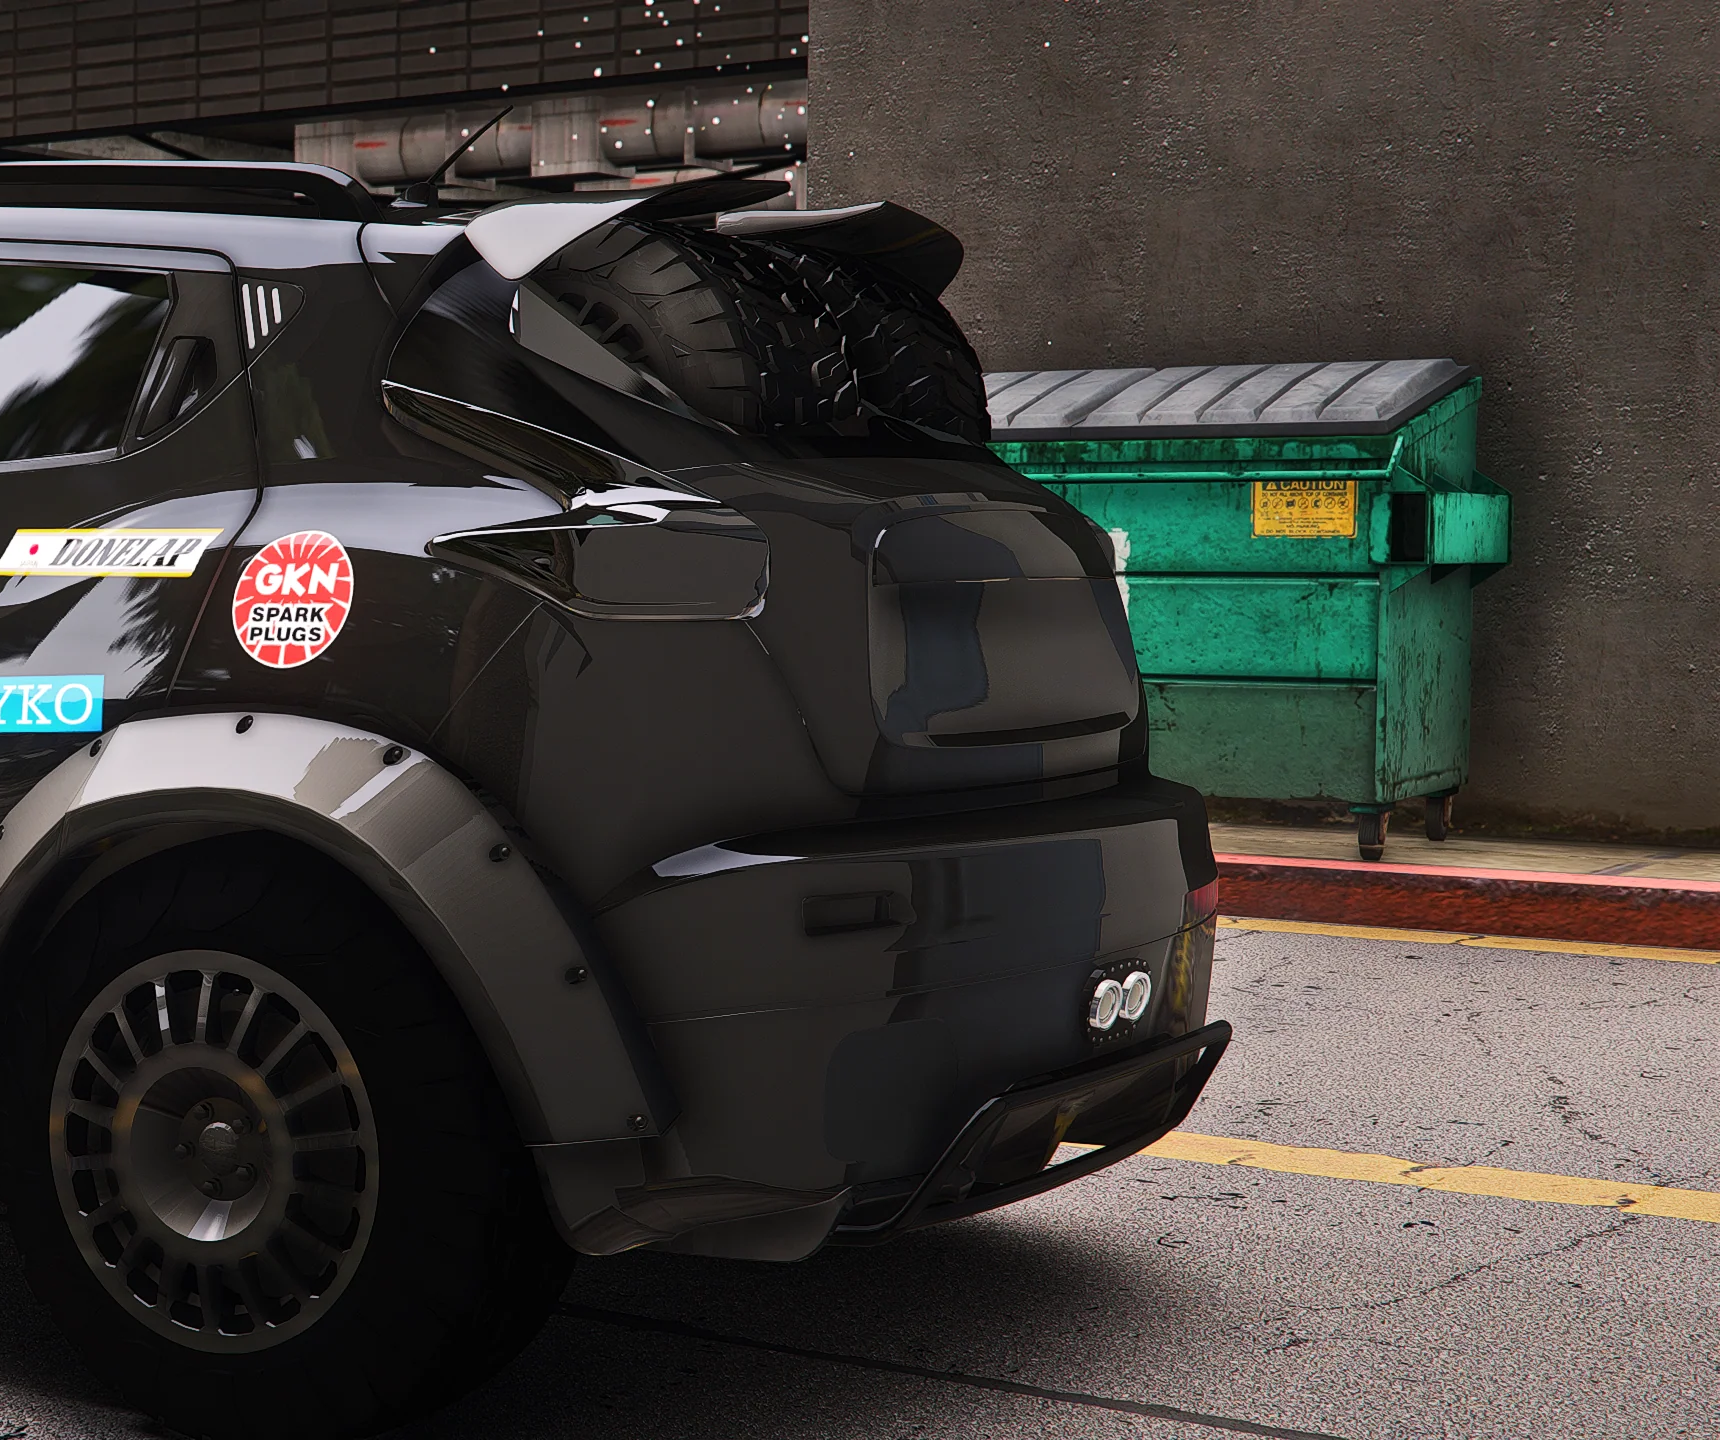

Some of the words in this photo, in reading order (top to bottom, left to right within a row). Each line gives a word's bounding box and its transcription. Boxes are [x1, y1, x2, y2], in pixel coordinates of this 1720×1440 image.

[1280, 481, 1344, 490] CAUTION
[49, 538, 203, 567] DONELAP
[255, 562, 340, 597] GKN
[252, 606, 325, 622] SPARK
[249, 626, 322, 642] PLUGS
